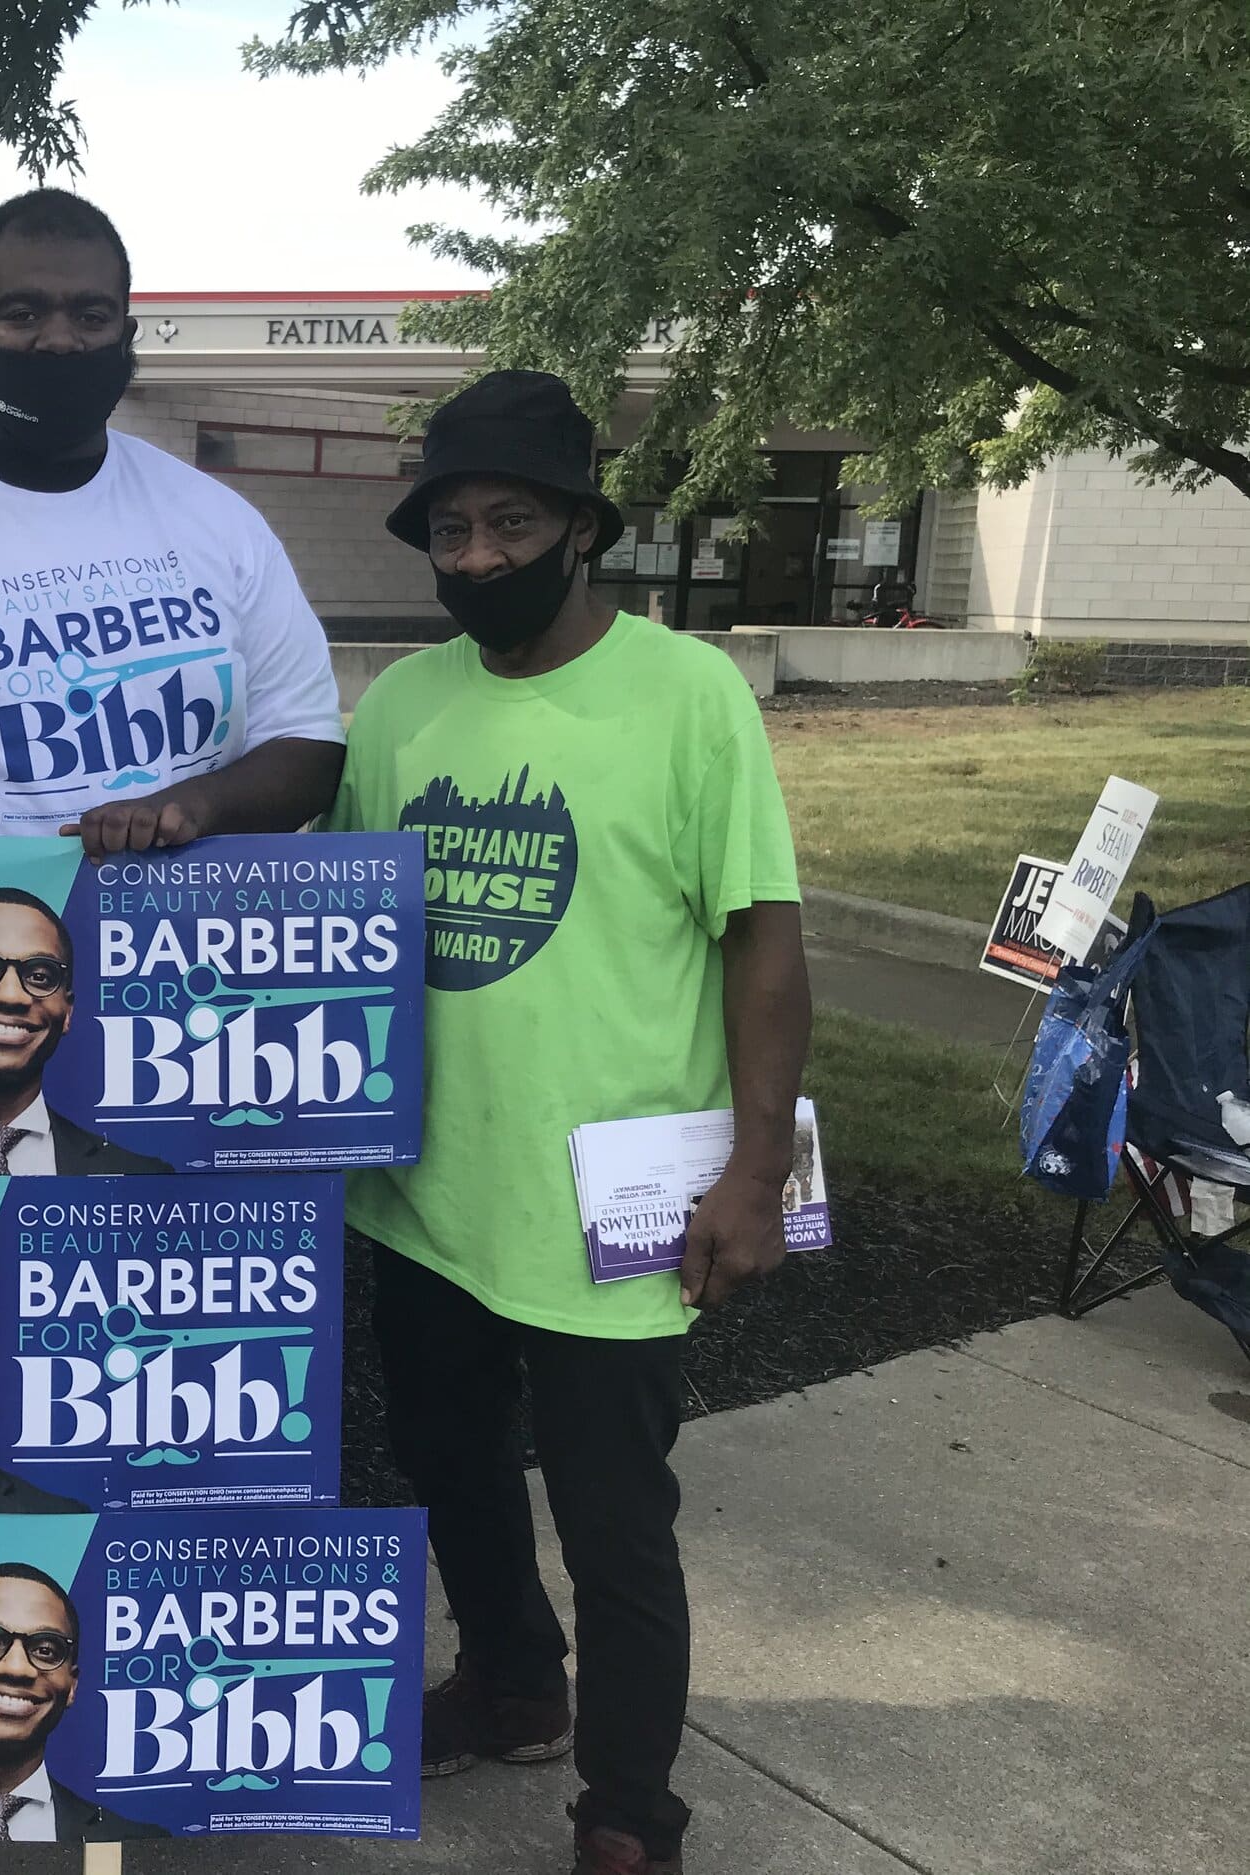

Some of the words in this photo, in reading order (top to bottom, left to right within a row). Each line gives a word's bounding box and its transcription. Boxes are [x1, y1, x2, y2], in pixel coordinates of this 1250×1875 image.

[266, 319, 389, 345] FATIMA
[85, 570, 188, 603] SALONS
[403, 824, 565, 871] TEPHANIE
[97, 859, 398, 887] CONSERVATIONISTS
[99, 890, 223, 913] BEAUTY
[234, 887, 366, 911] SALONS
[379, 888, 398, 909] &
[424, 867, 556, 914] OWSE
[100, 914, 398, 977] BARBERS
[434, 930, 501, 963] WARD
[508, 938, 526, 965] 7
[100, 981, 179, 1011] FOR
[93, 1004, 396, 1108] Bibb!
[613, 1192, 639, 1200] VOTING
[640, 1189, 661, 1197] EARLY
[659, 1200, 676, 1209] FOR
[17, 1201, 317, 1228] CONSERVATIONISTS
[599, 1210, 682, 1234] WILLIAMS
[601, 1202, 655, 1216] CLEVELAND
[624, 1229, 660, 1240] SANDRA
[805, 1220, 826, 1230] WITH
[817, 1228, 827, 1239] A
[19, 1231, 143, 1254] BEAUTY
[154, 1228, 285, 1252] SALONS
[298, 1229, 317, 1250] &
[19, 1255, 317, 1318] BARBERS
[19, 1323, 98, 1352] FOR
[11, 1343, 314, 1448] Bibb!
[105, 1535, 401, 1563] CONSERVATIONISTS
[106, 1565, 228, 1590] BEAUTY
[239, 1562, 369, 1586] SALONS
[381, 1562, 400, 1583] &
[105, 1589, 400, 1652] BARBERS
[104, 1655, 180, 1684] FOR
[97, 1674, 395, 1778] Bibb!
